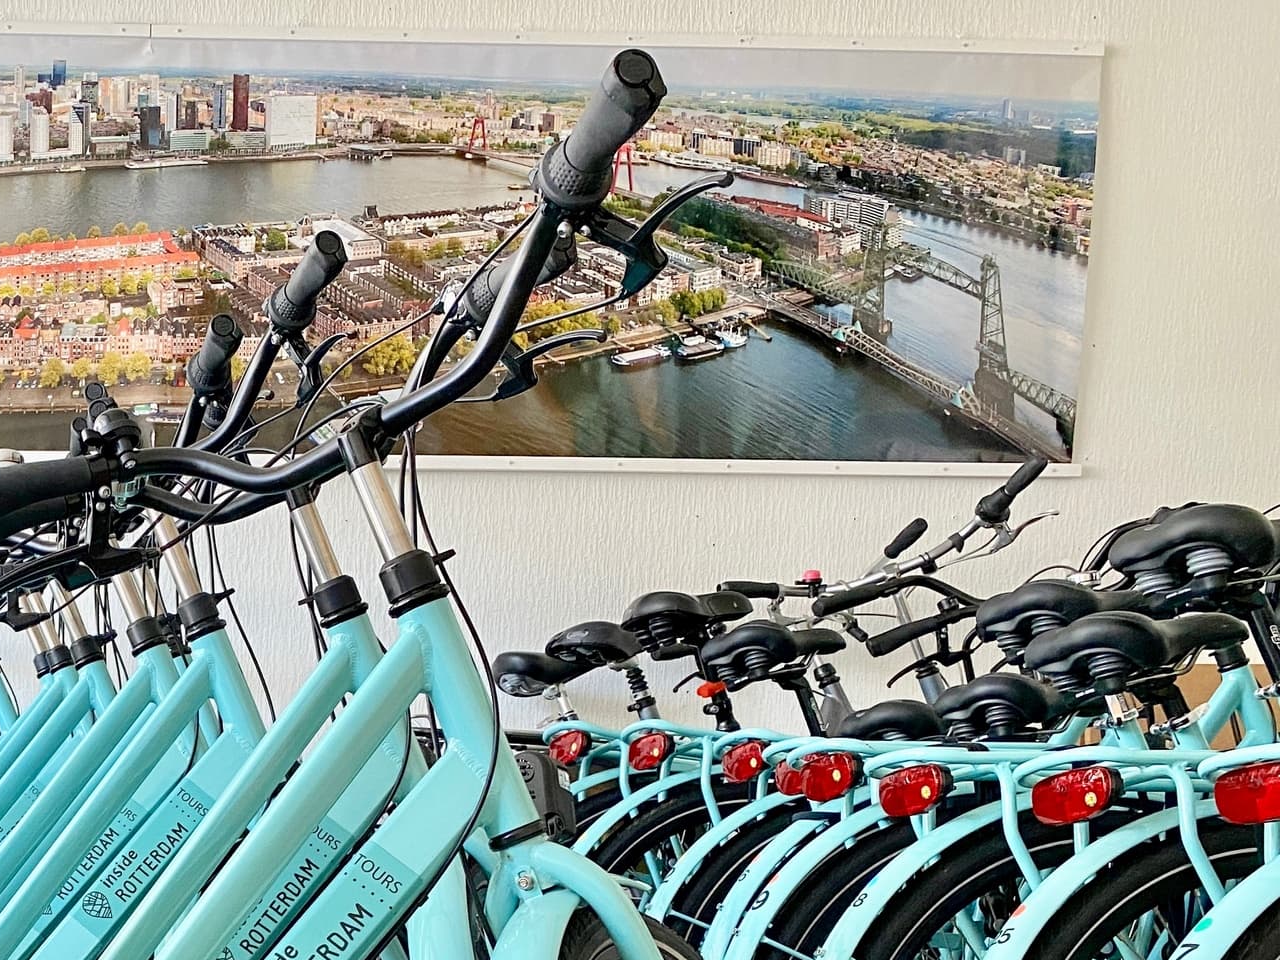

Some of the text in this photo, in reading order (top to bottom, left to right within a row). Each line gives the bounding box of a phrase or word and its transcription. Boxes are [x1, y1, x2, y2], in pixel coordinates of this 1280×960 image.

[176, 787, 209, 817] TOURS
[100, 849, 138, 889] inside
[115, 822, 189, 902] ROTTERDAM
[352, 853, 403, 894] TOURS
[238, 857, 320, 955] ROTTERDAM
